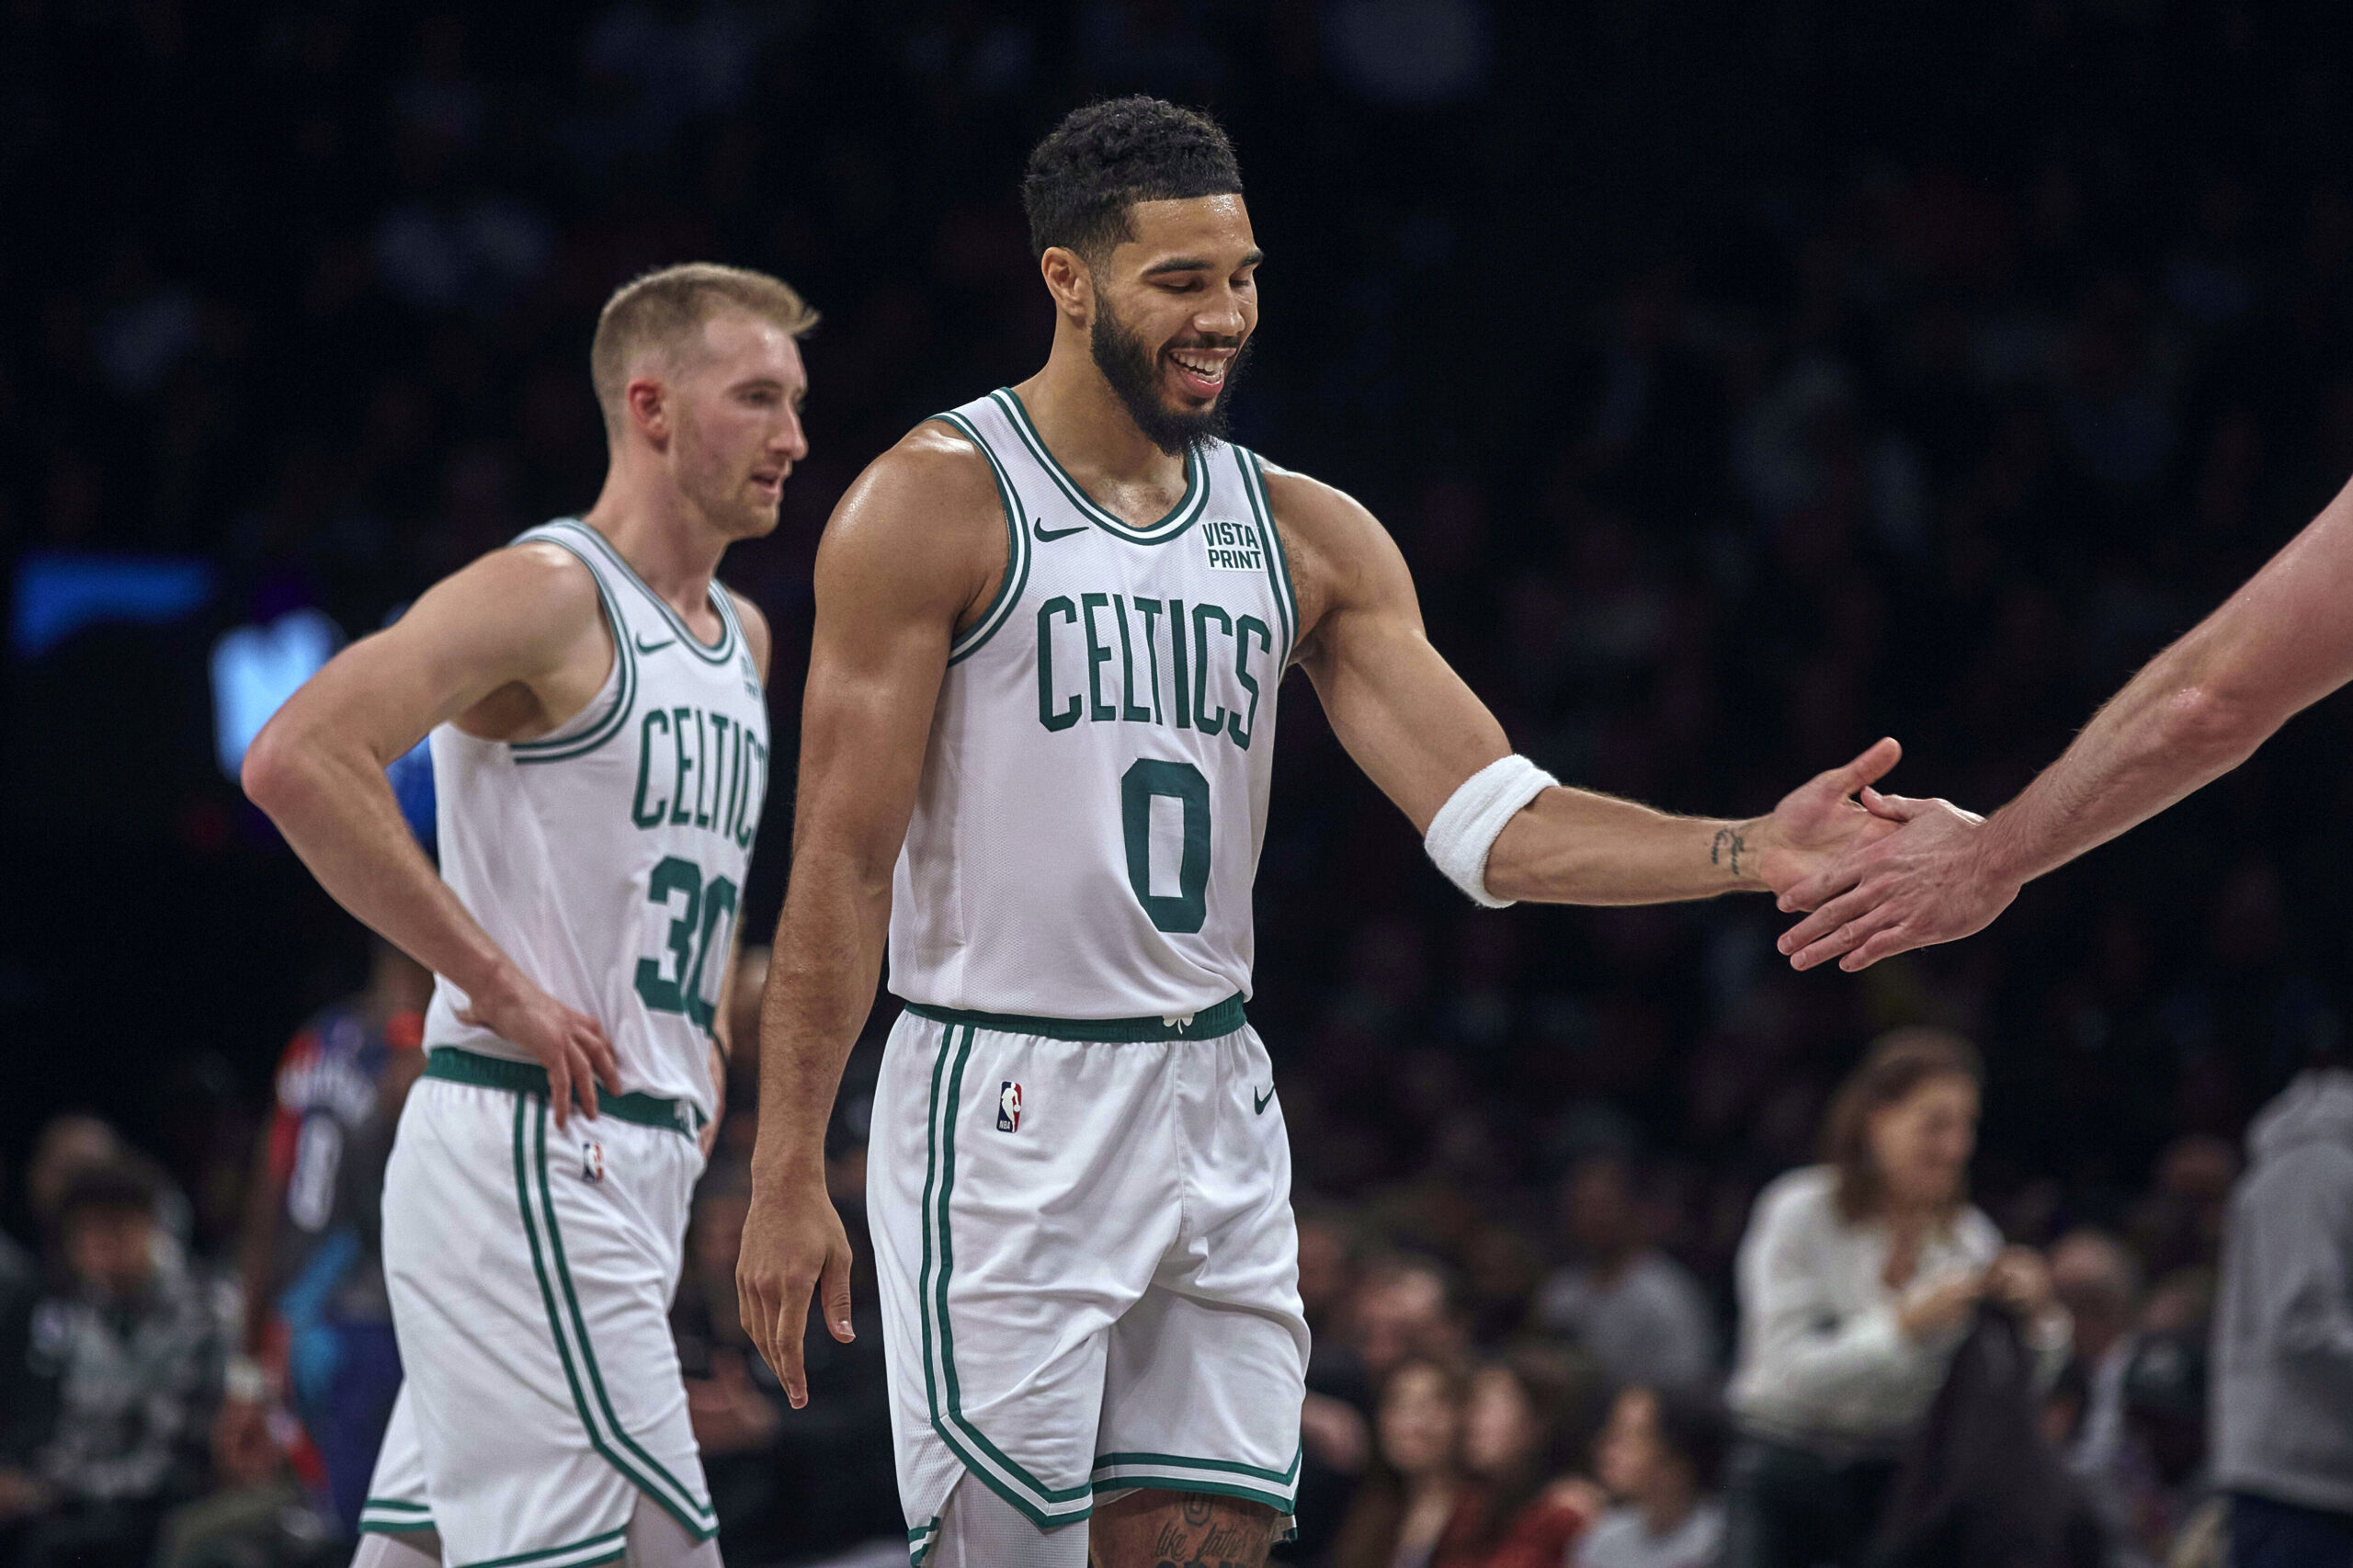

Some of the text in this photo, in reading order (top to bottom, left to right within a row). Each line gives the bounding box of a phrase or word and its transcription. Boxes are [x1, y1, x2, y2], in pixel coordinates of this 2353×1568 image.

[1202, 522, 1259, 550] VISTA
[1208, 549, 1261, 569] PRINT
[1038, 593, 1271, 751] CELTICS
[1121, 758, 1211, 934] 0
[633, 856, 737, 1038] 30
[998, 1120, 1011, 1130] NBA
